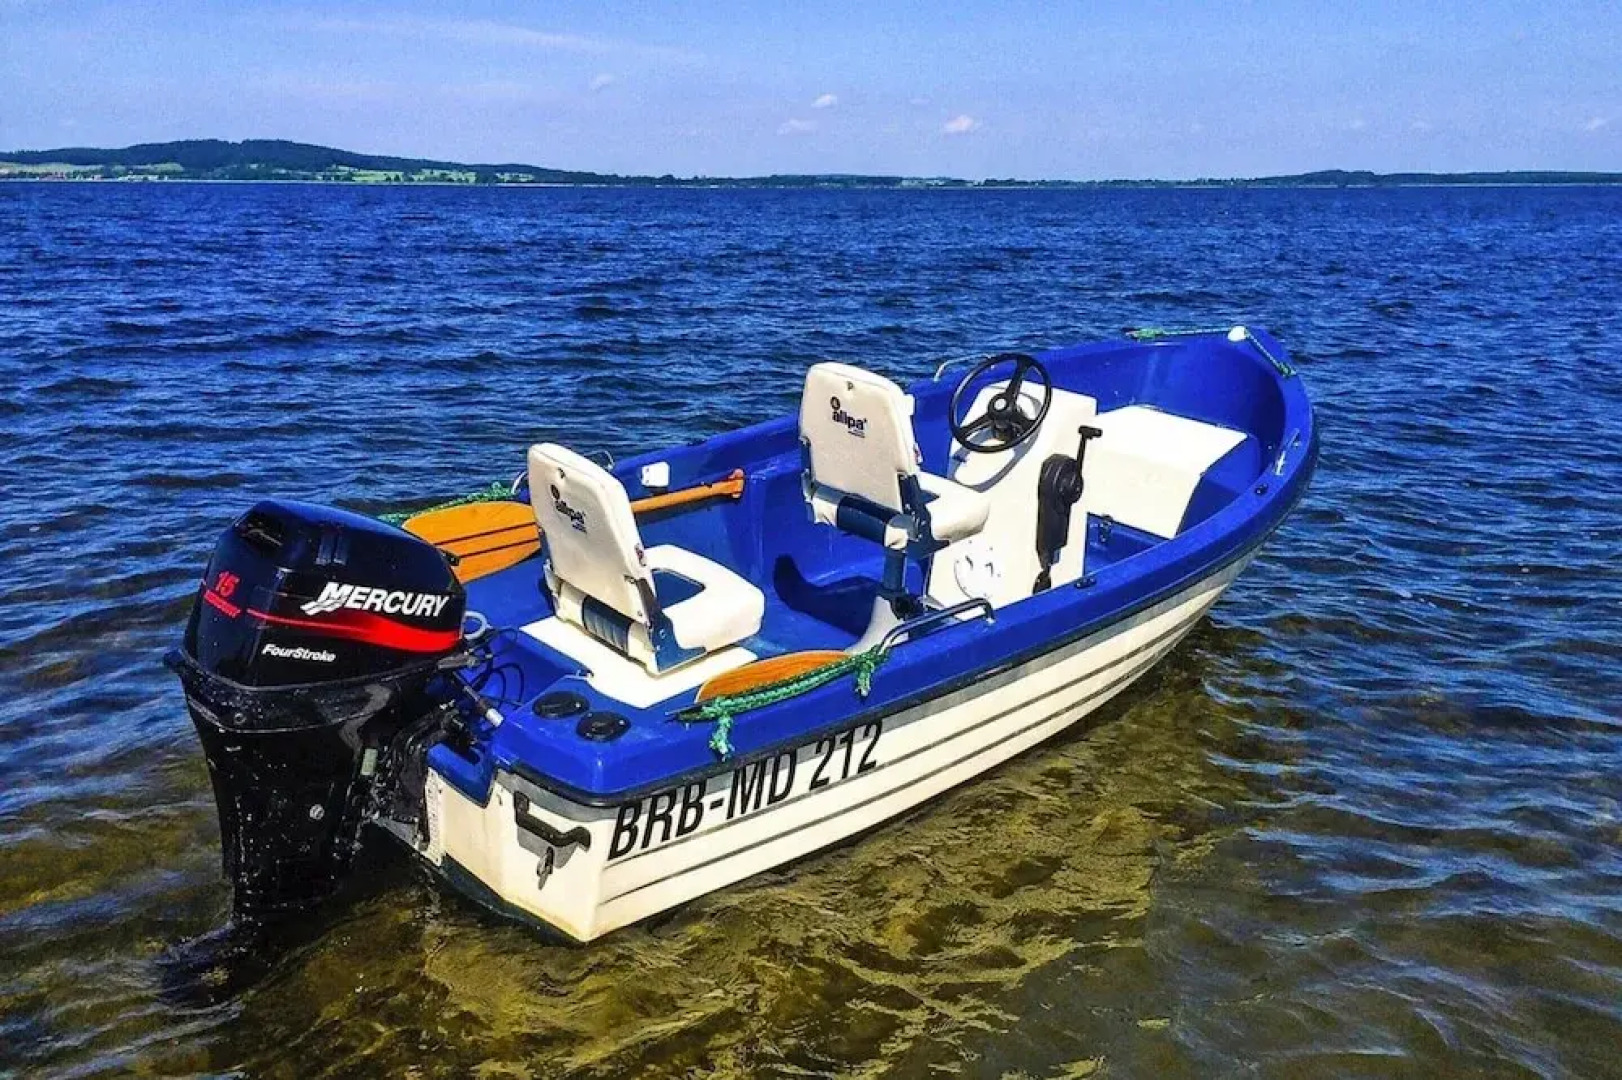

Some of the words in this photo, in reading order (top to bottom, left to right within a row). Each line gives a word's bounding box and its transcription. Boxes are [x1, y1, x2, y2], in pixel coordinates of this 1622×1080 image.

[215, 571, 240, 597] 15
[300, 581, 449, 617] MERCURY
[262, 643, 336, 662] FourStroke
[608, 750, 797, 861] BRB-MD
[809, 720, 882, 791] 212
